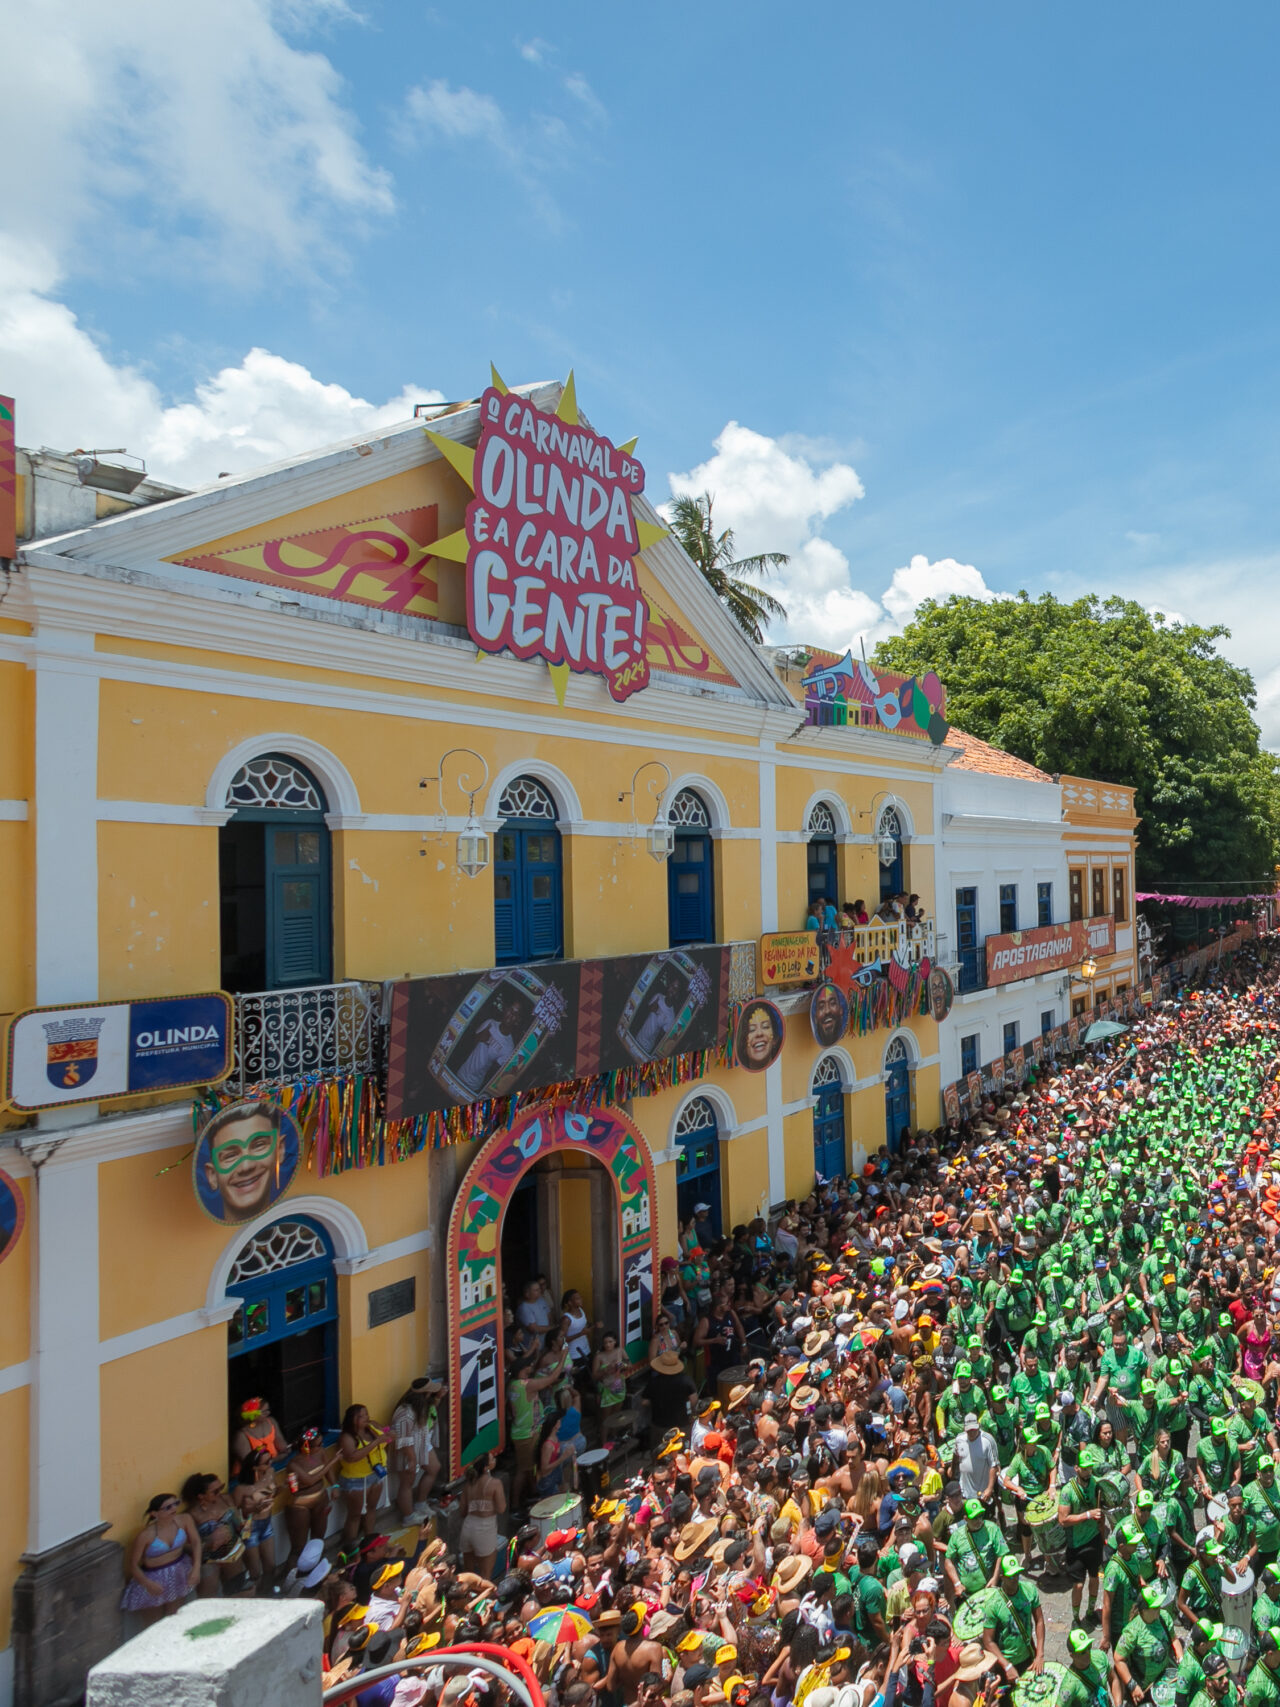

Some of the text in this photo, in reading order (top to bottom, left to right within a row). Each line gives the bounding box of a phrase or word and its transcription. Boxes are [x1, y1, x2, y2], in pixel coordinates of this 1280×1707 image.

[487, 396, 639, 484] O CARNAVAL DE
[481, 435, 632, 544] OLINDA
[492, 517, 509, 547] A
[514, 520, 600, 584] CARA
[607, 554, 635, 591] DA
[473, 550, 644, 670] GENTE!
[614, 659, 646, 691] 2024
[992, 936, 1072, 971] APOSTAGANHA
[135, 1043, 220, 1058] PREFEITURA MUNICIPAL
[136, 1024, 220, 1048] OLINDA
